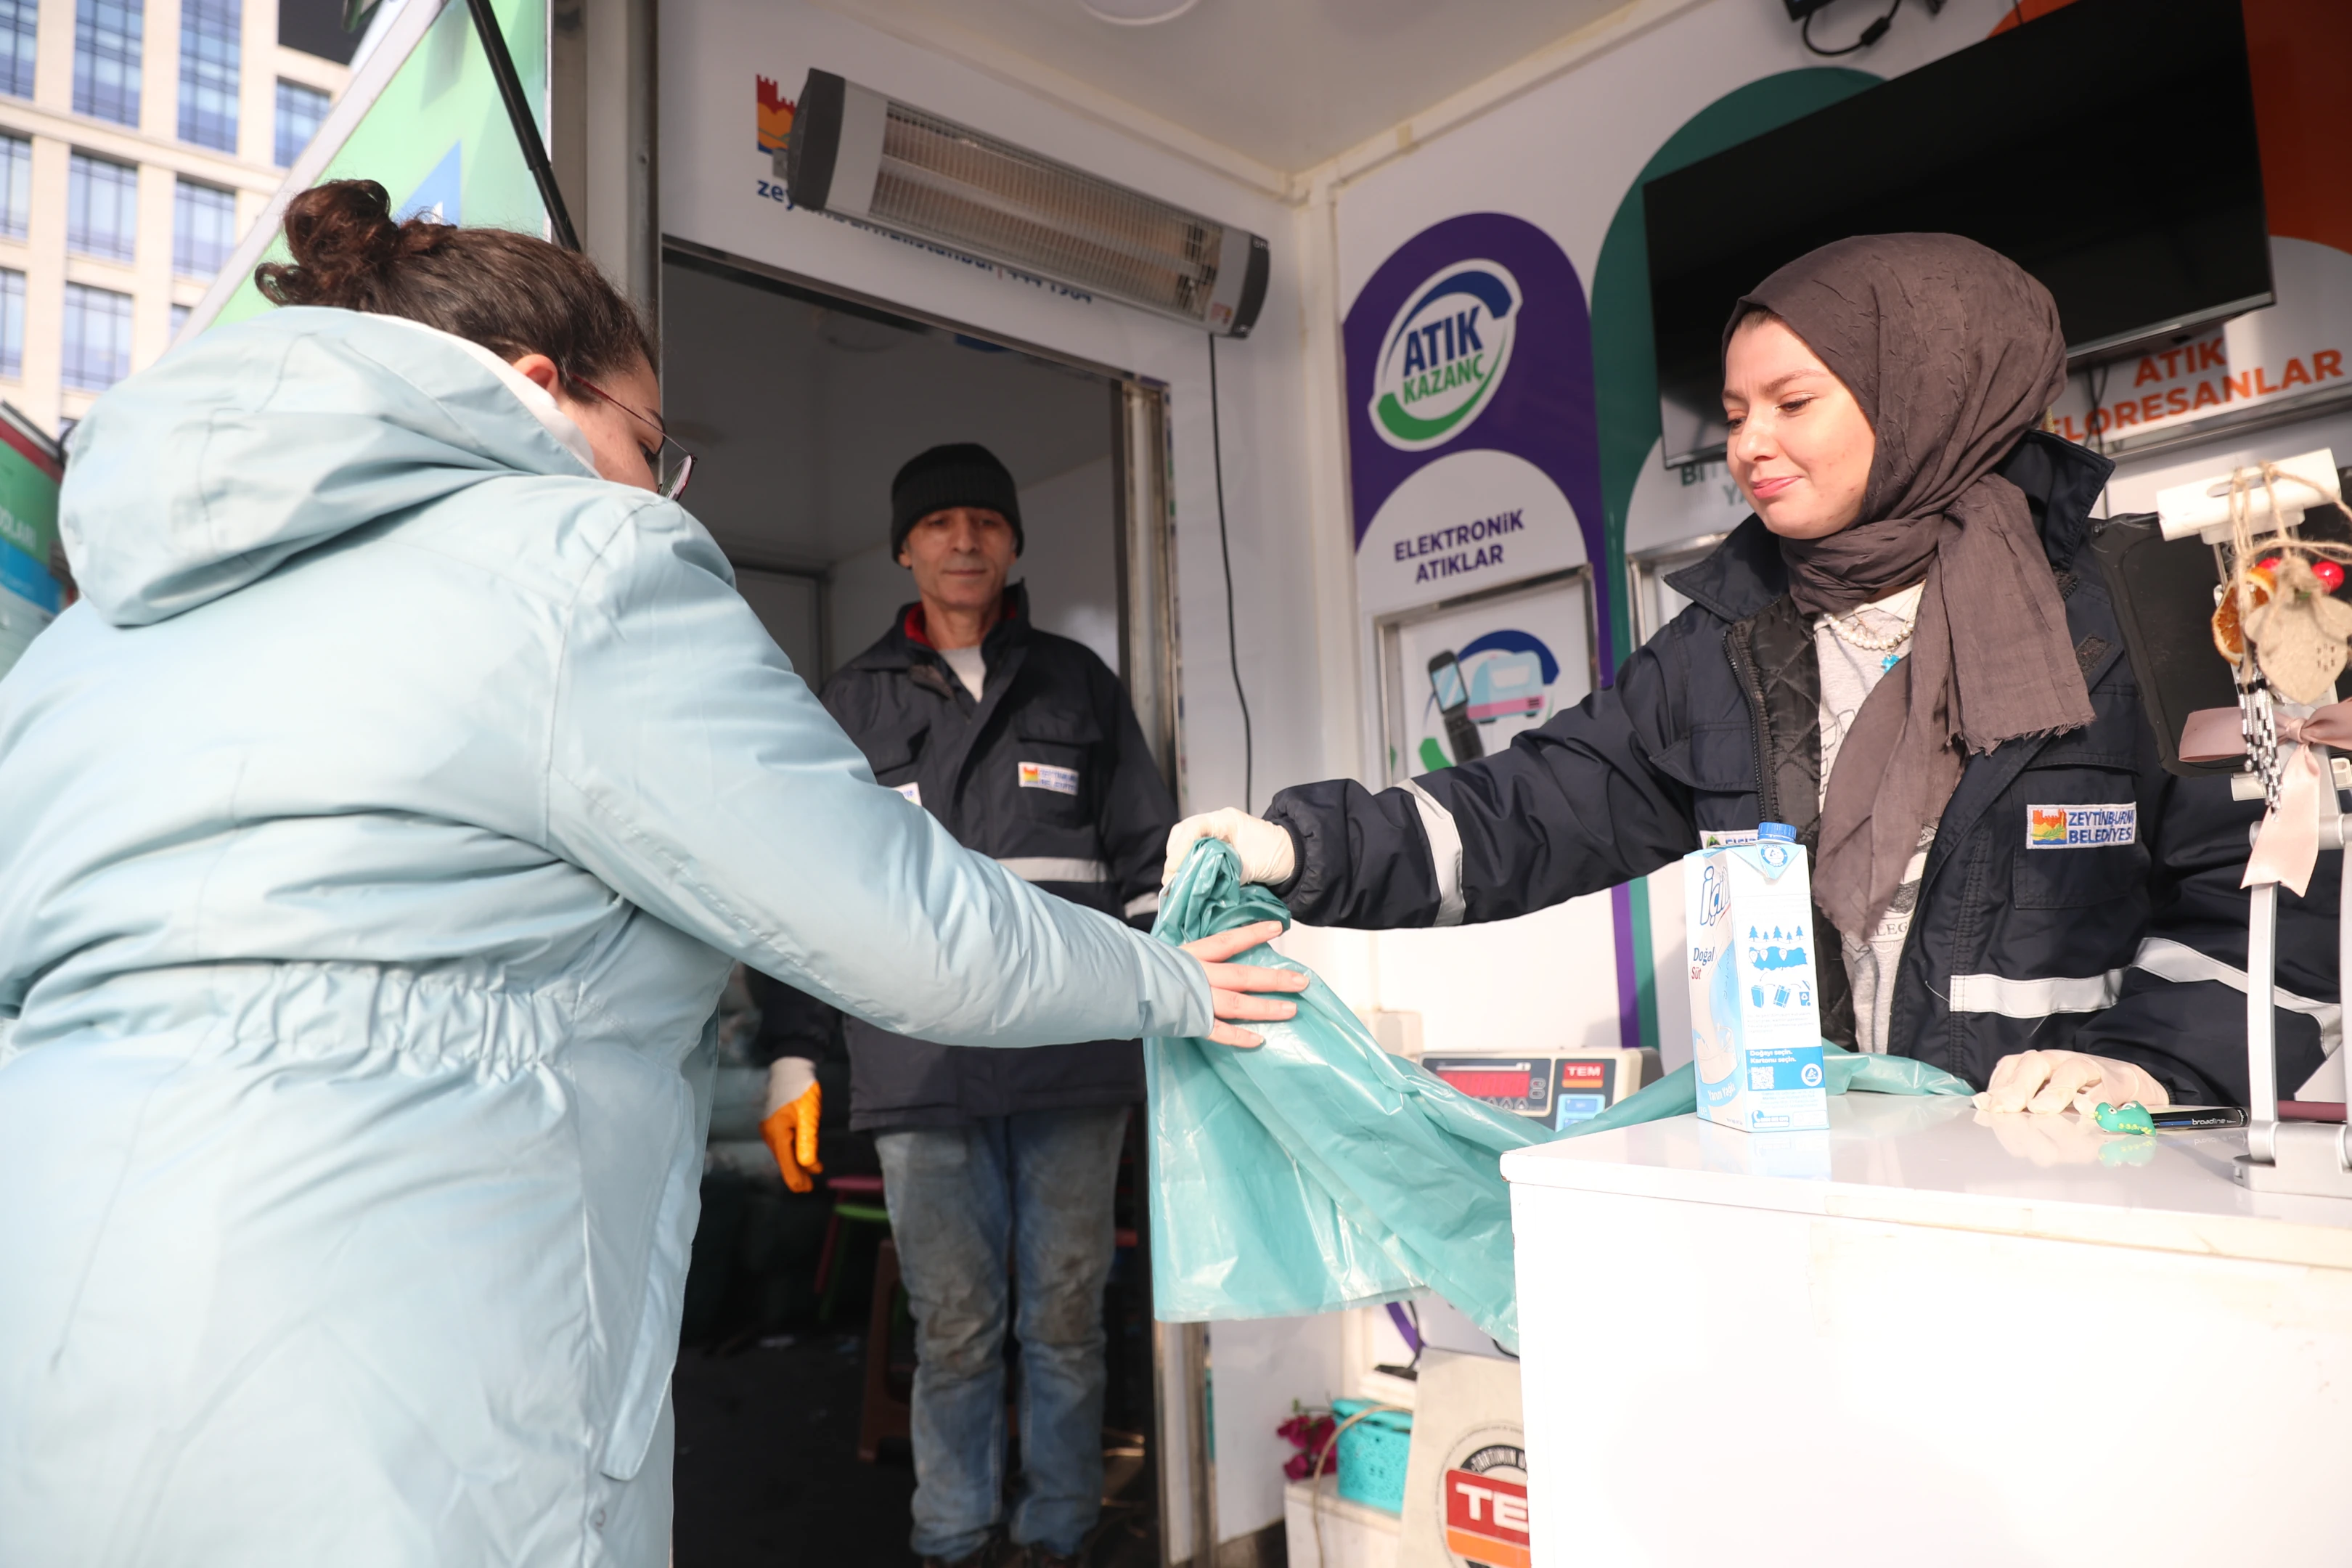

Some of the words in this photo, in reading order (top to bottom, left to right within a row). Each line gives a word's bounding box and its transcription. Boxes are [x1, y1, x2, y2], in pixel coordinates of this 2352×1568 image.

[1403, 306, 1483, 377] ATIK
[2133, 337, 2227, 389] ATIK
[1416, 544, 1503, 584] ATIKLAR
[1691, 966, 1702, 980] Süt
[1693, 947, 1715, 965] Doğal
[1567, 1066, 1601, 1077] TEM
[1455, 1482, 1529, 1533] TE
